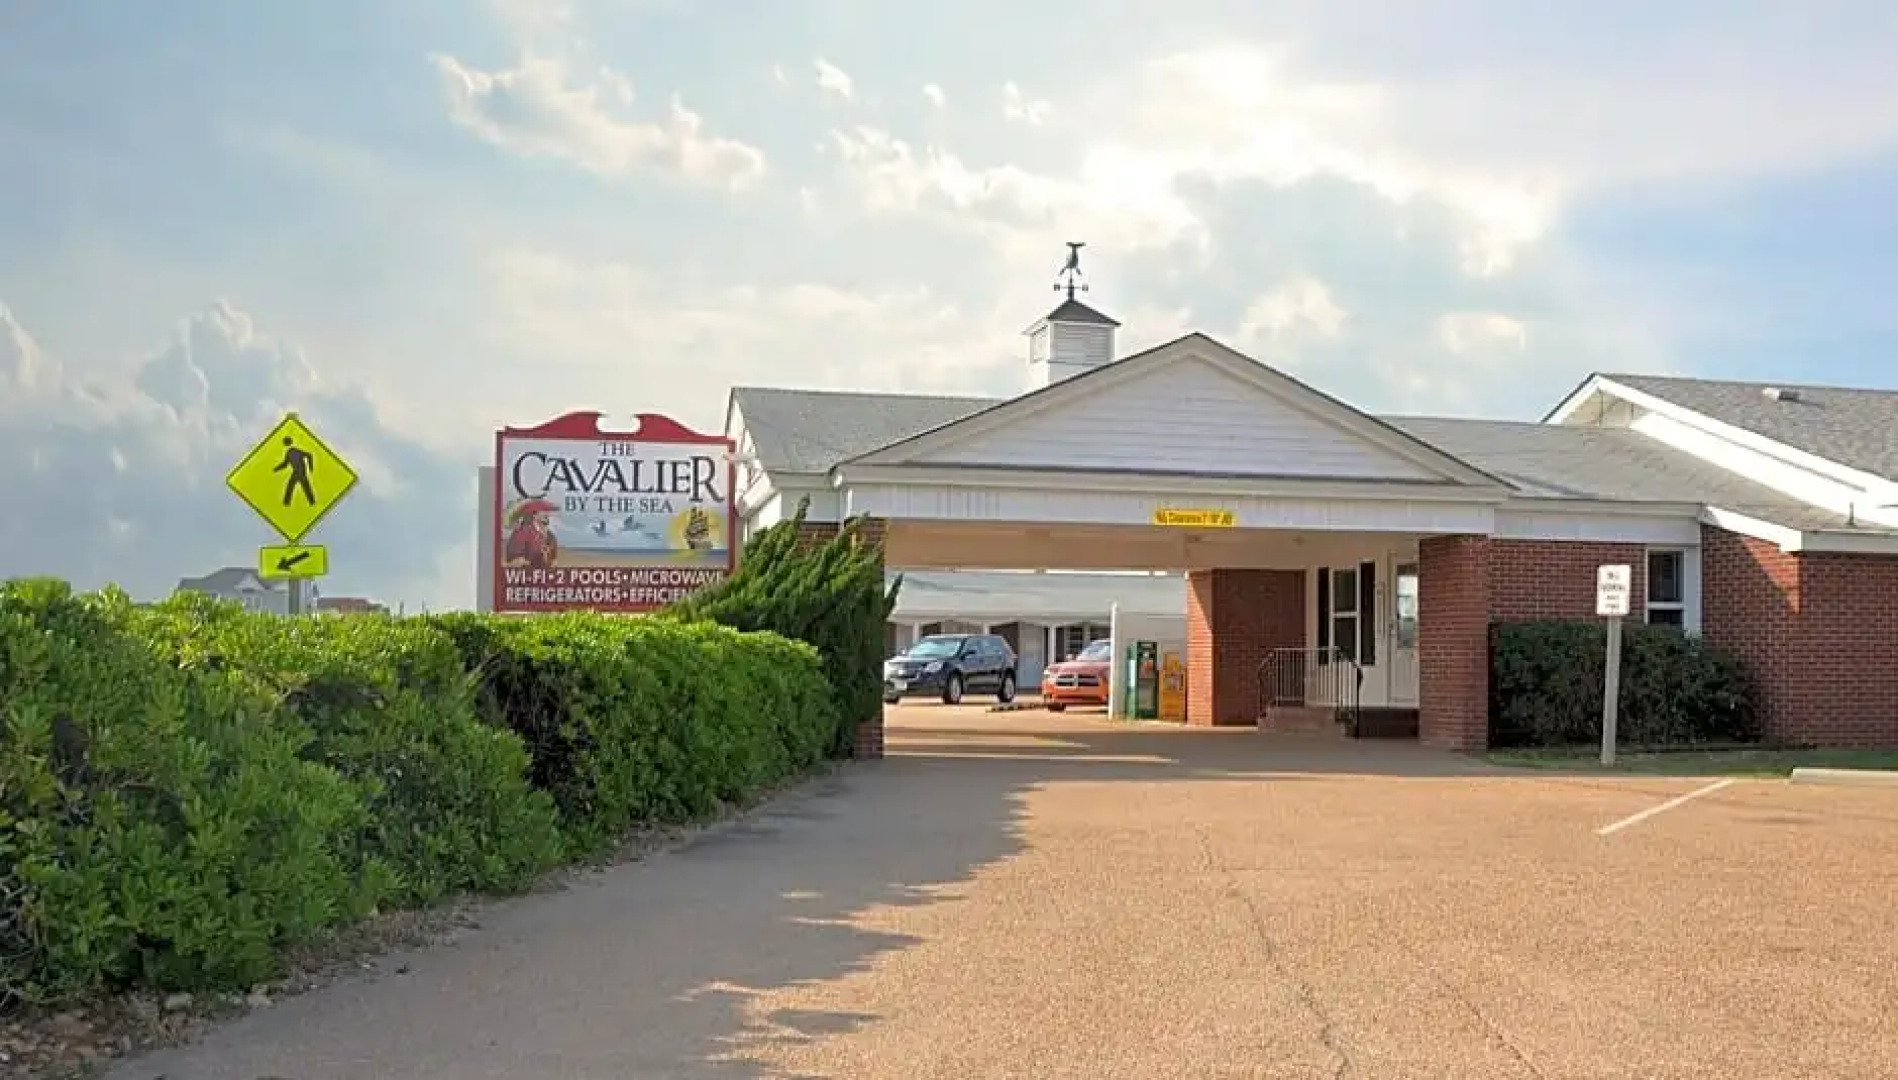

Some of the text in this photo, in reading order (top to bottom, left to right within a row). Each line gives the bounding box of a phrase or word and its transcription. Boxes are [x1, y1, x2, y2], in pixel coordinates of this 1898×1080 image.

[599, 442, 635, 457] THE
[513, 452, 725, 503] CAVALIER
[565, 496, 673, 513] BY THE SEA
[570, 570, 622, 585] POOLS
[506, 587, 622, 603] REFRIGERATORS
